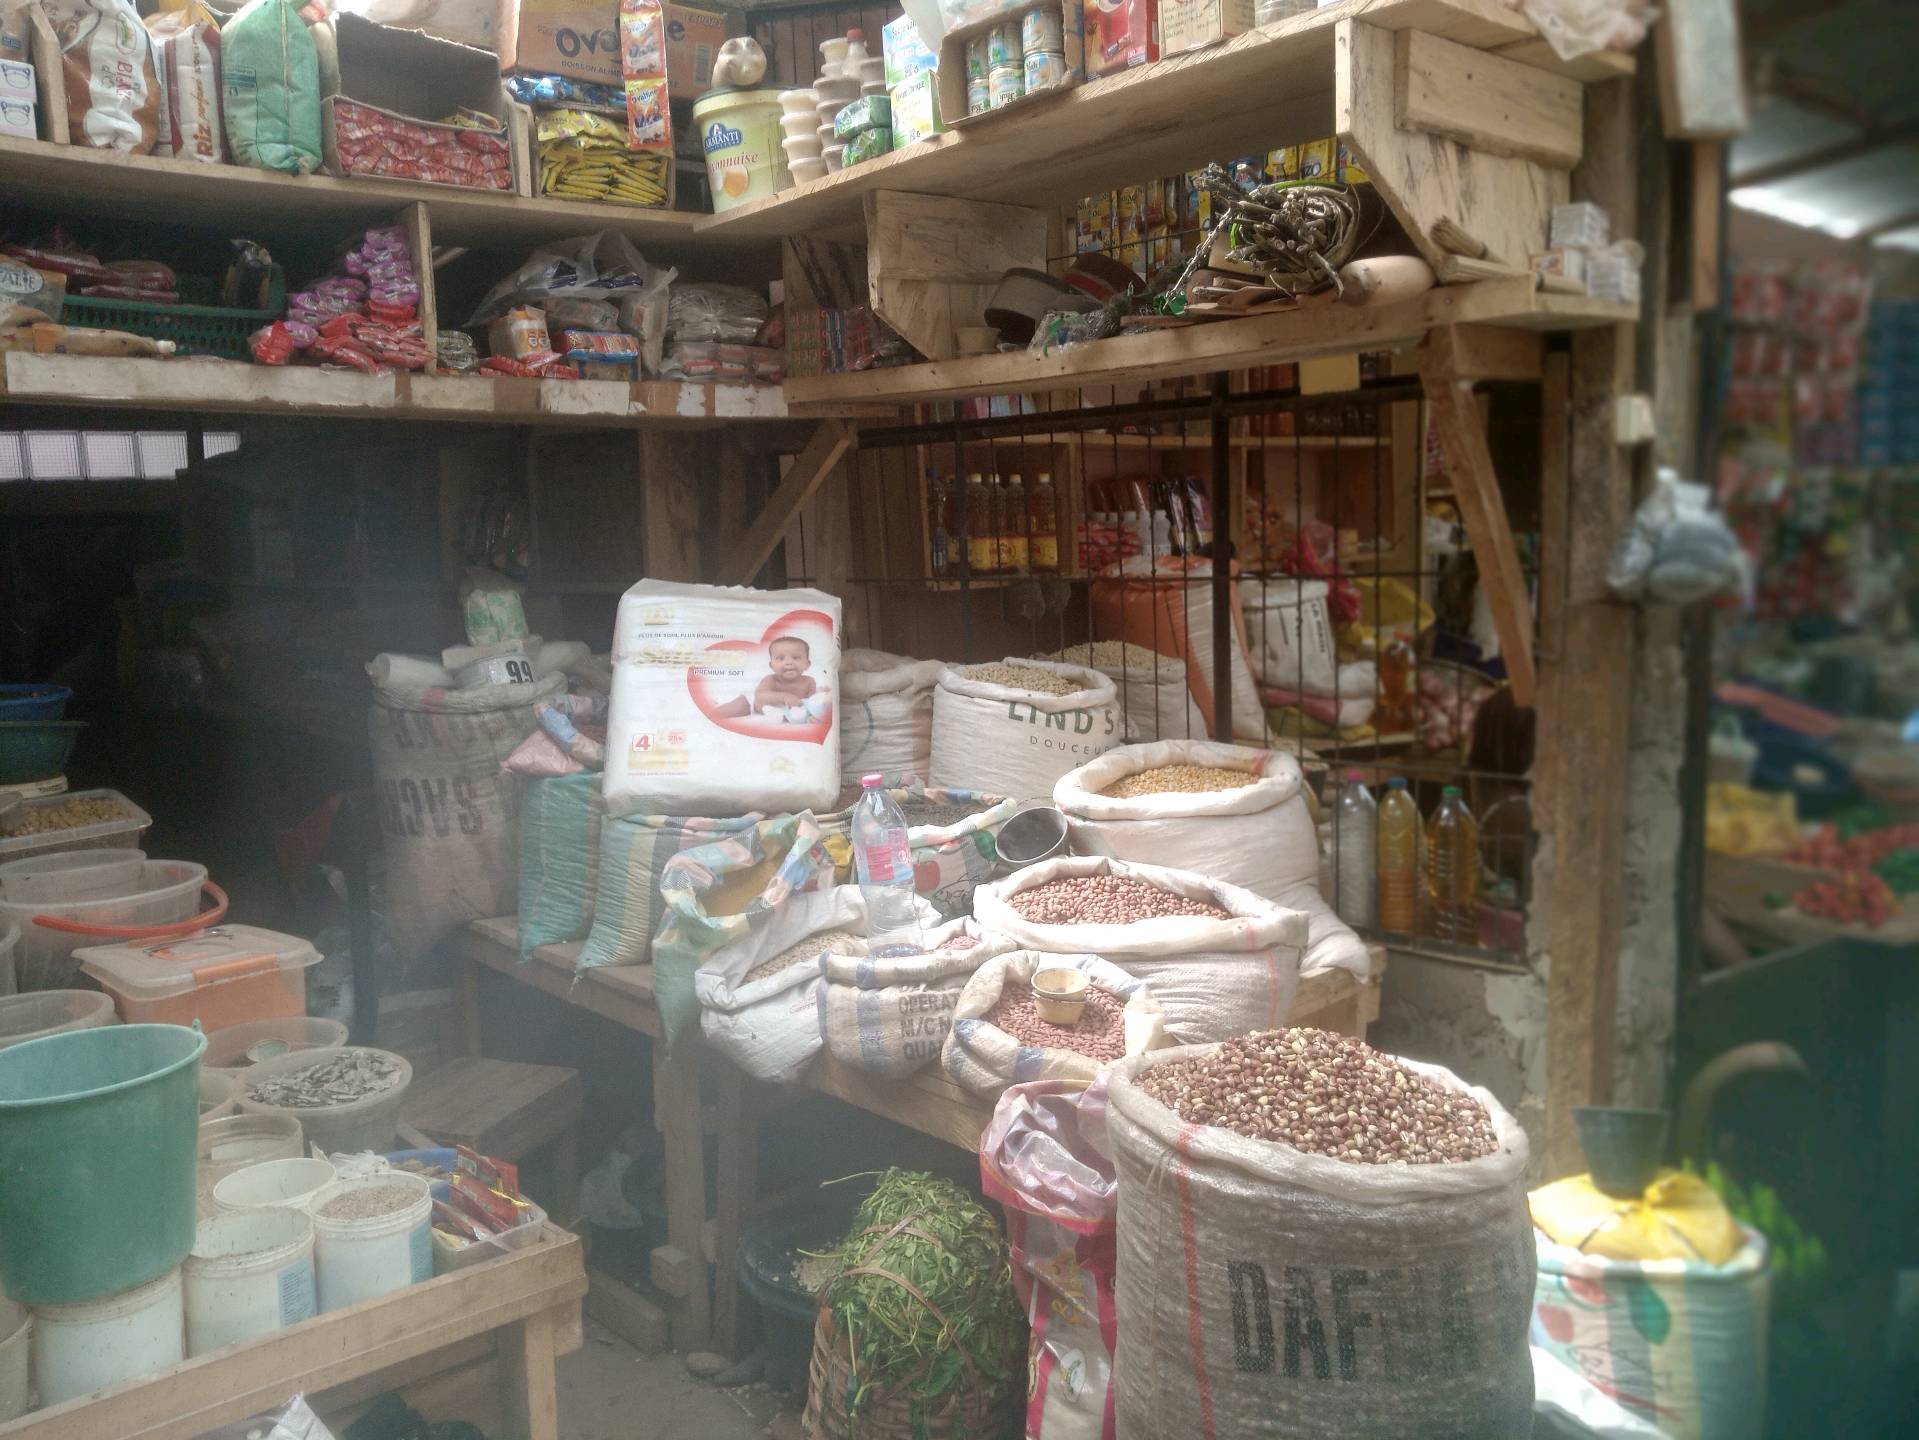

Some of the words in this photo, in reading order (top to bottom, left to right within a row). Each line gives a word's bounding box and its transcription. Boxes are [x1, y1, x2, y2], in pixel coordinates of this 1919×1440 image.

[694, 668, 726, 677] PREMIUM
[727, 669, 745, 677] SOFT
[634, 734, 651, 750] 4
